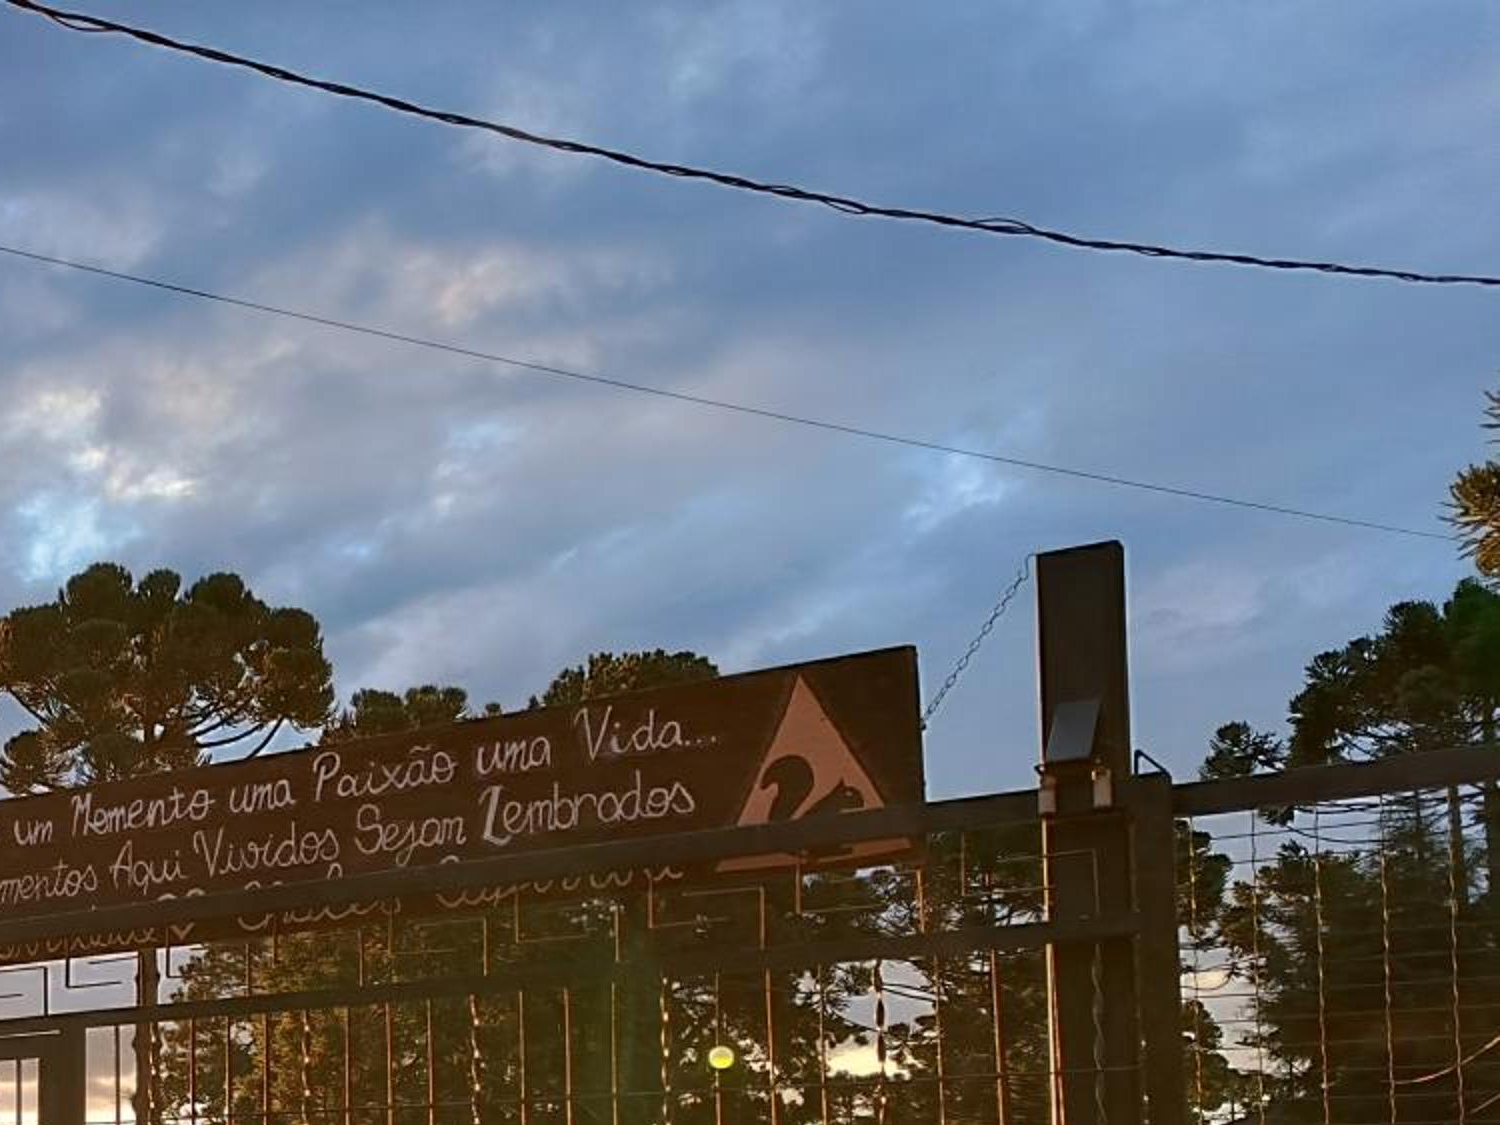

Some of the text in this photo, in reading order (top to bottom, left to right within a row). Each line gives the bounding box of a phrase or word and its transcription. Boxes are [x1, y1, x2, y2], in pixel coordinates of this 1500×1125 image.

[14, 818, 53, 845] um
[71, 787, 215, 837] Momento
[229, 779, 296, 813] uma
[313, 745, 458, 801] Paixão
[476, 736, 551, 775] uma
[573, 705, 717, 760] Vida...
[109, 839, 189, 895] Aqui
[193, 821, 339, 877] Vividos
[354, 804, 467, 868] Sejam
[479, 769, 695, 846] Lembrados
